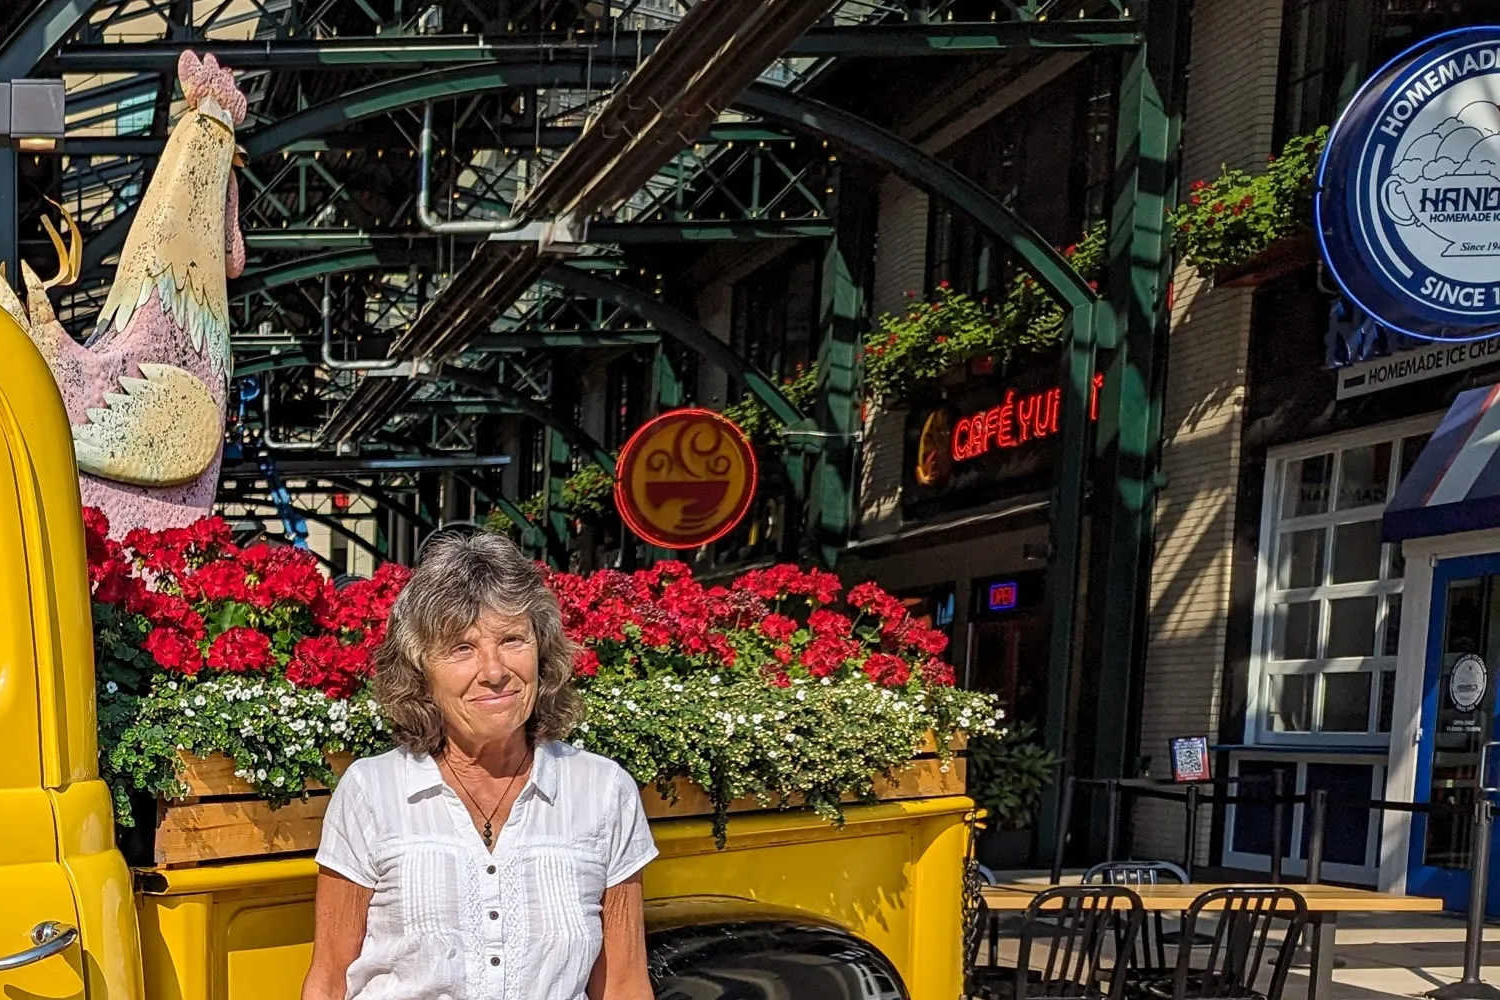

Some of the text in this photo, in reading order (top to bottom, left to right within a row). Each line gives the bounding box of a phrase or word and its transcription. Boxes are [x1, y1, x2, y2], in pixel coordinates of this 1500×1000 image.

[1429, 212, 1491, 224] HOMEMADE
[1460, 242, 1486, 252] Since
[1420, 276, 1485, 307] SINCE
[1368, 354, 1442, 385] HOMEMADE
[1446, 345, 1465, 364] ICE
